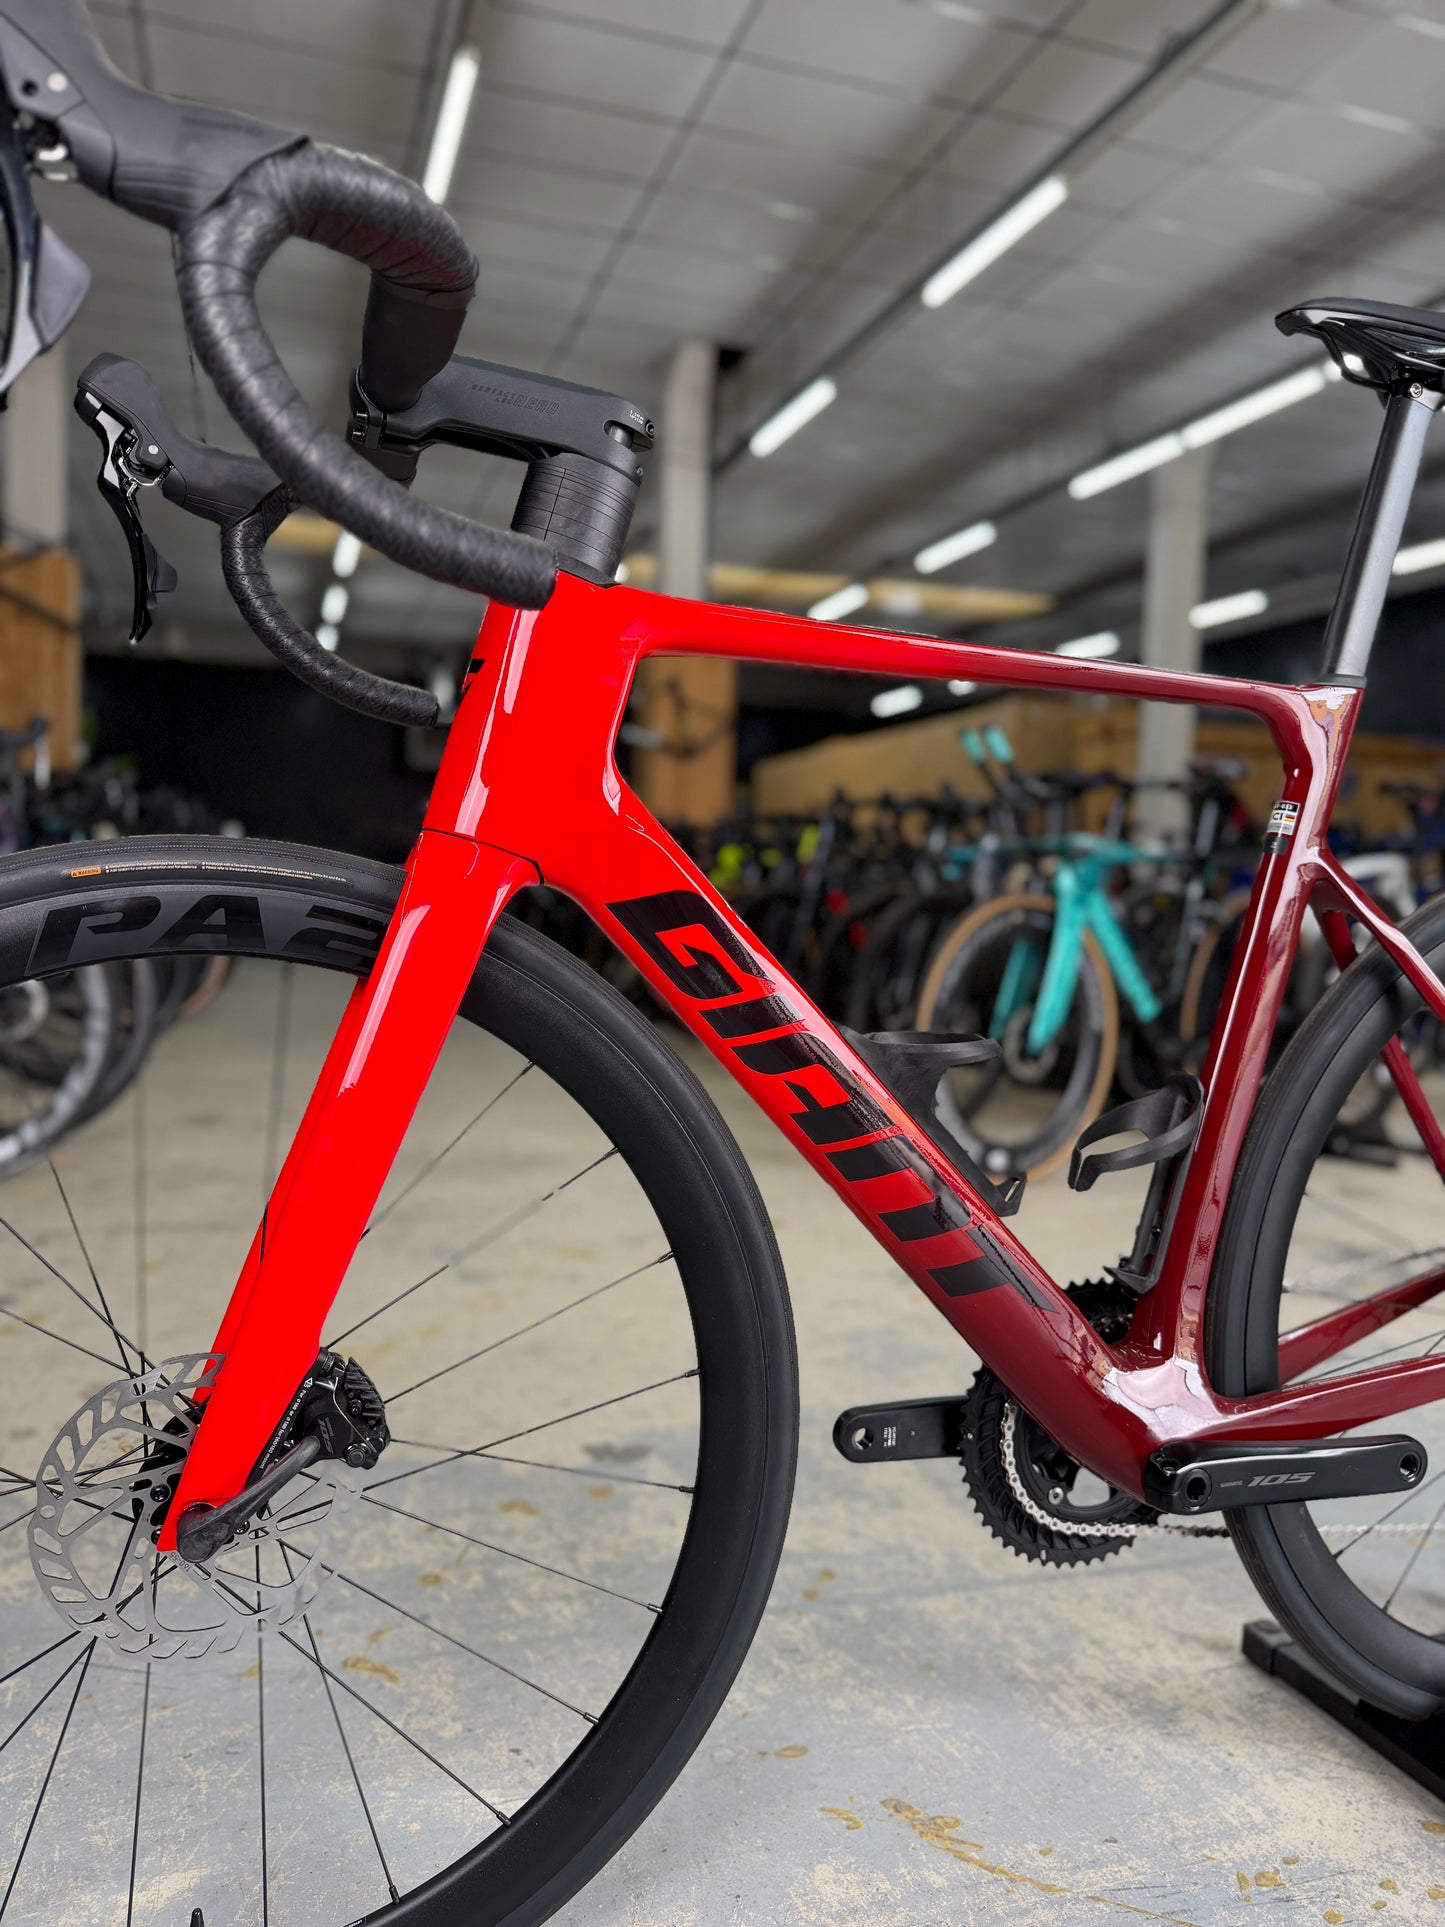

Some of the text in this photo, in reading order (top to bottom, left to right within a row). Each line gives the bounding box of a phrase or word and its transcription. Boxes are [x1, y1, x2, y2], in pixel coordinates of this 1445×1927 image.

[606, 889, 1059, 1312] GIANT
[317, 1418, 334, 1454] 105
[1247, 1471, 1316, 1487] 105
